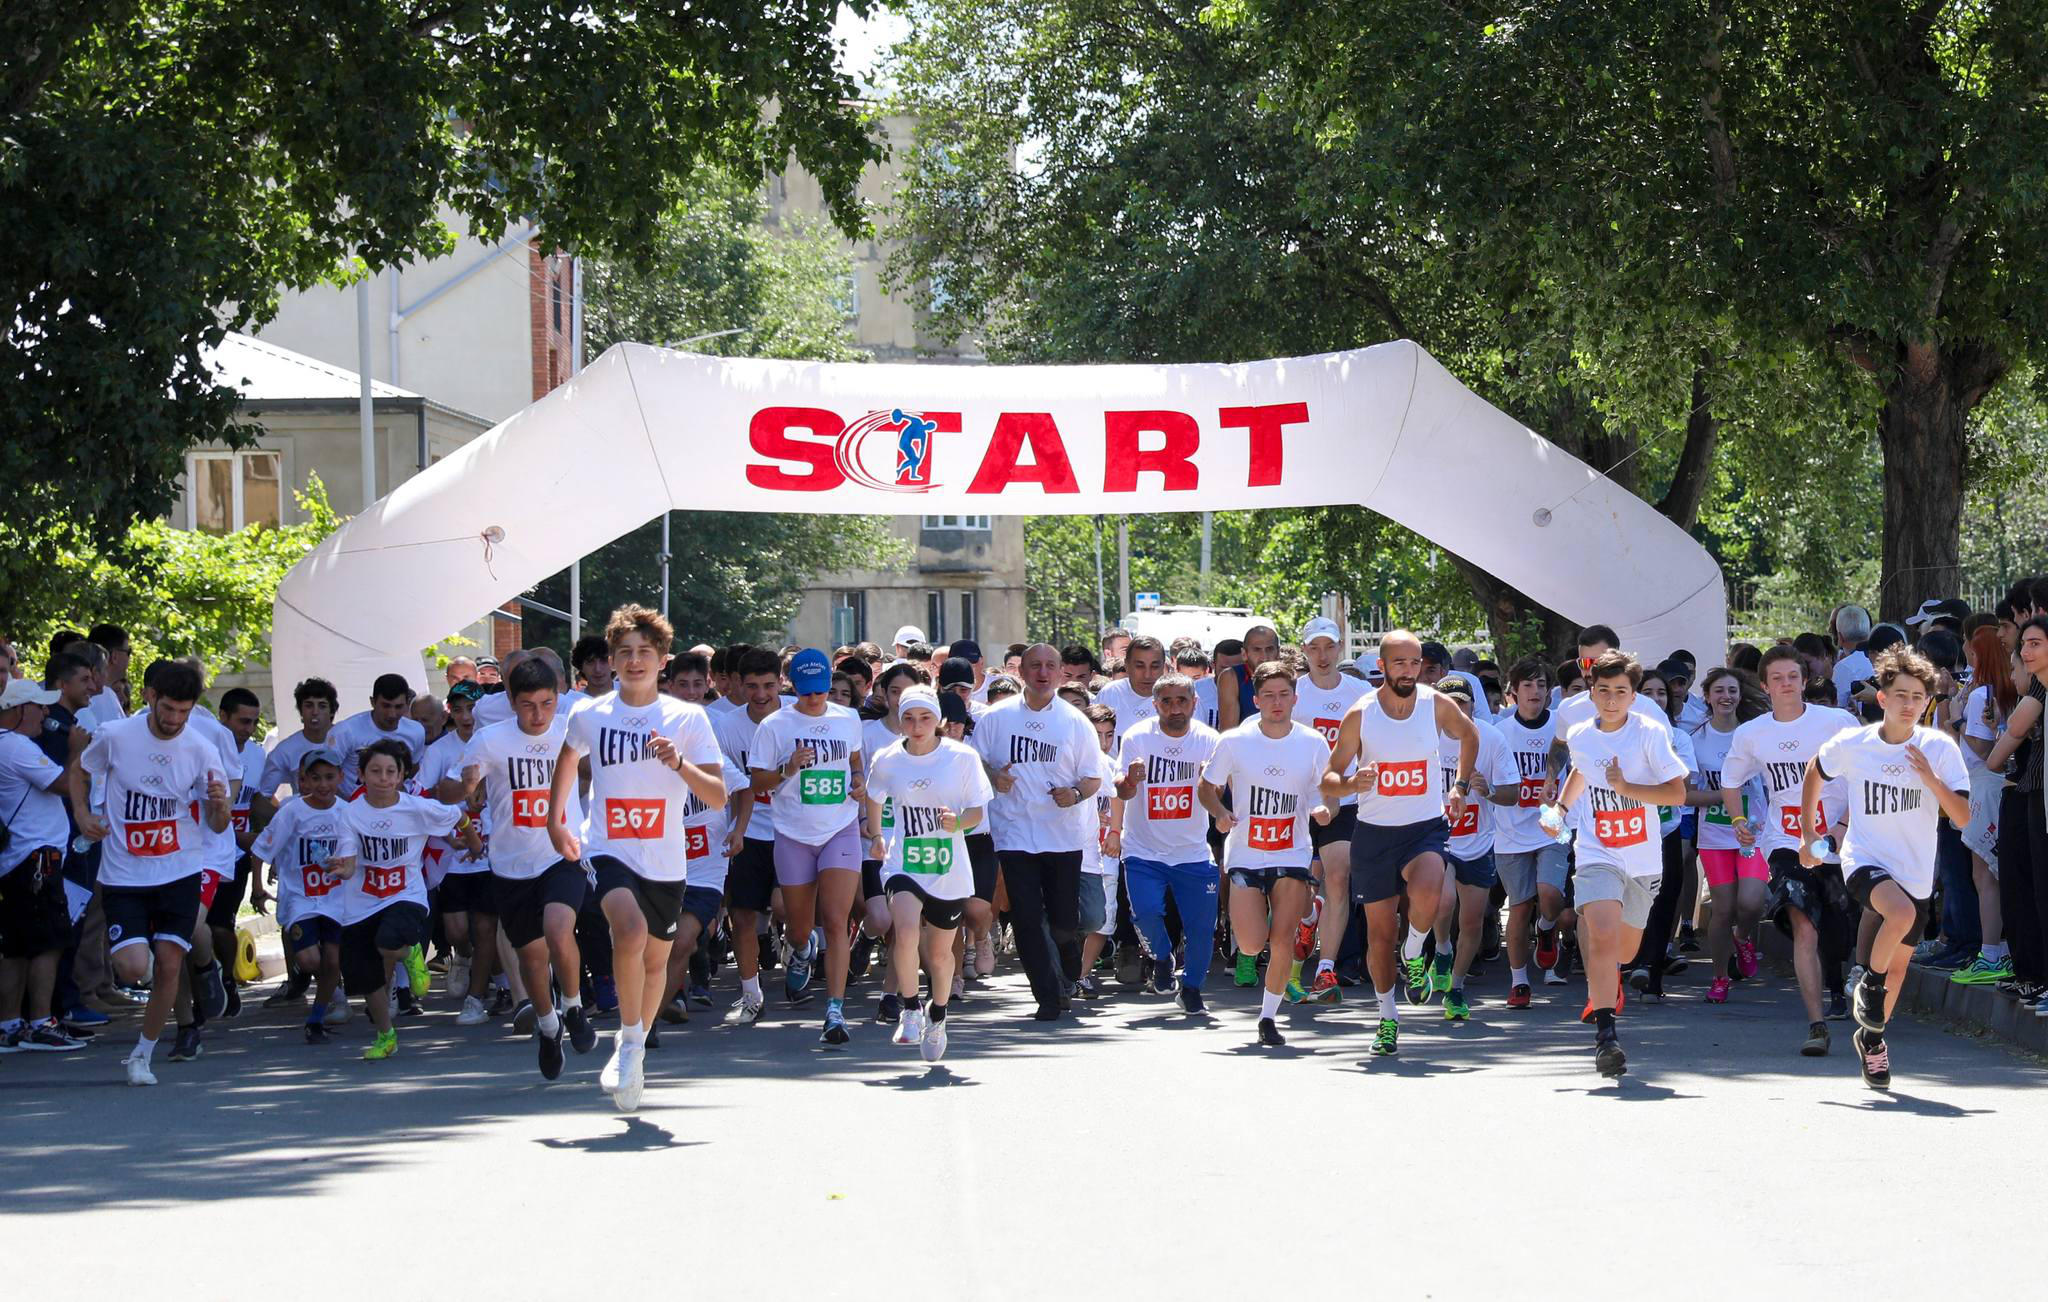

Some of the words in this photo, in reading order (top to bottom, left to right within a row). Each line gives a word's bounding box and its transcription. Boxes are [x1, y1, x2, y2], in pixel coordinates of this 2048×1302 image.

[746, 402, 1309, 494] START
[600, 728, 638, 767] LET'S
[1011, 735, 1038, 764] LET'S
[508, 757, 545, 790] LET'S
[1148, 755, 1175, 784] LET'S
[1381, 769, 1424, 788] 005
[1767, 762, 1798, 792] LET'S
[804, 778, 842, 796] 585
[1249, 785, 1280, 815] LET'S
[1864, 780, 1898, 815] LET'S
[1901, 788, 1922, 812] MOVE
[125, 790, 157, 821] LET'S
[518, 798, 549, 818] 10
[1152, 793, 1190, 811] 106
[1589, 785, 1619, 818] LET'S
[611, 808, 660, 829] 367
[902, 805, 936, 837] LET'S
[1600, 816, 1643, 837] 319
[130, 826, 174, 848] 078
[359, 833, 388, 860] LET'S
[1253, 824, 1291, 843] 114
[907, 846, 950, 865] 530
[369, 869, 403, 890] 118
